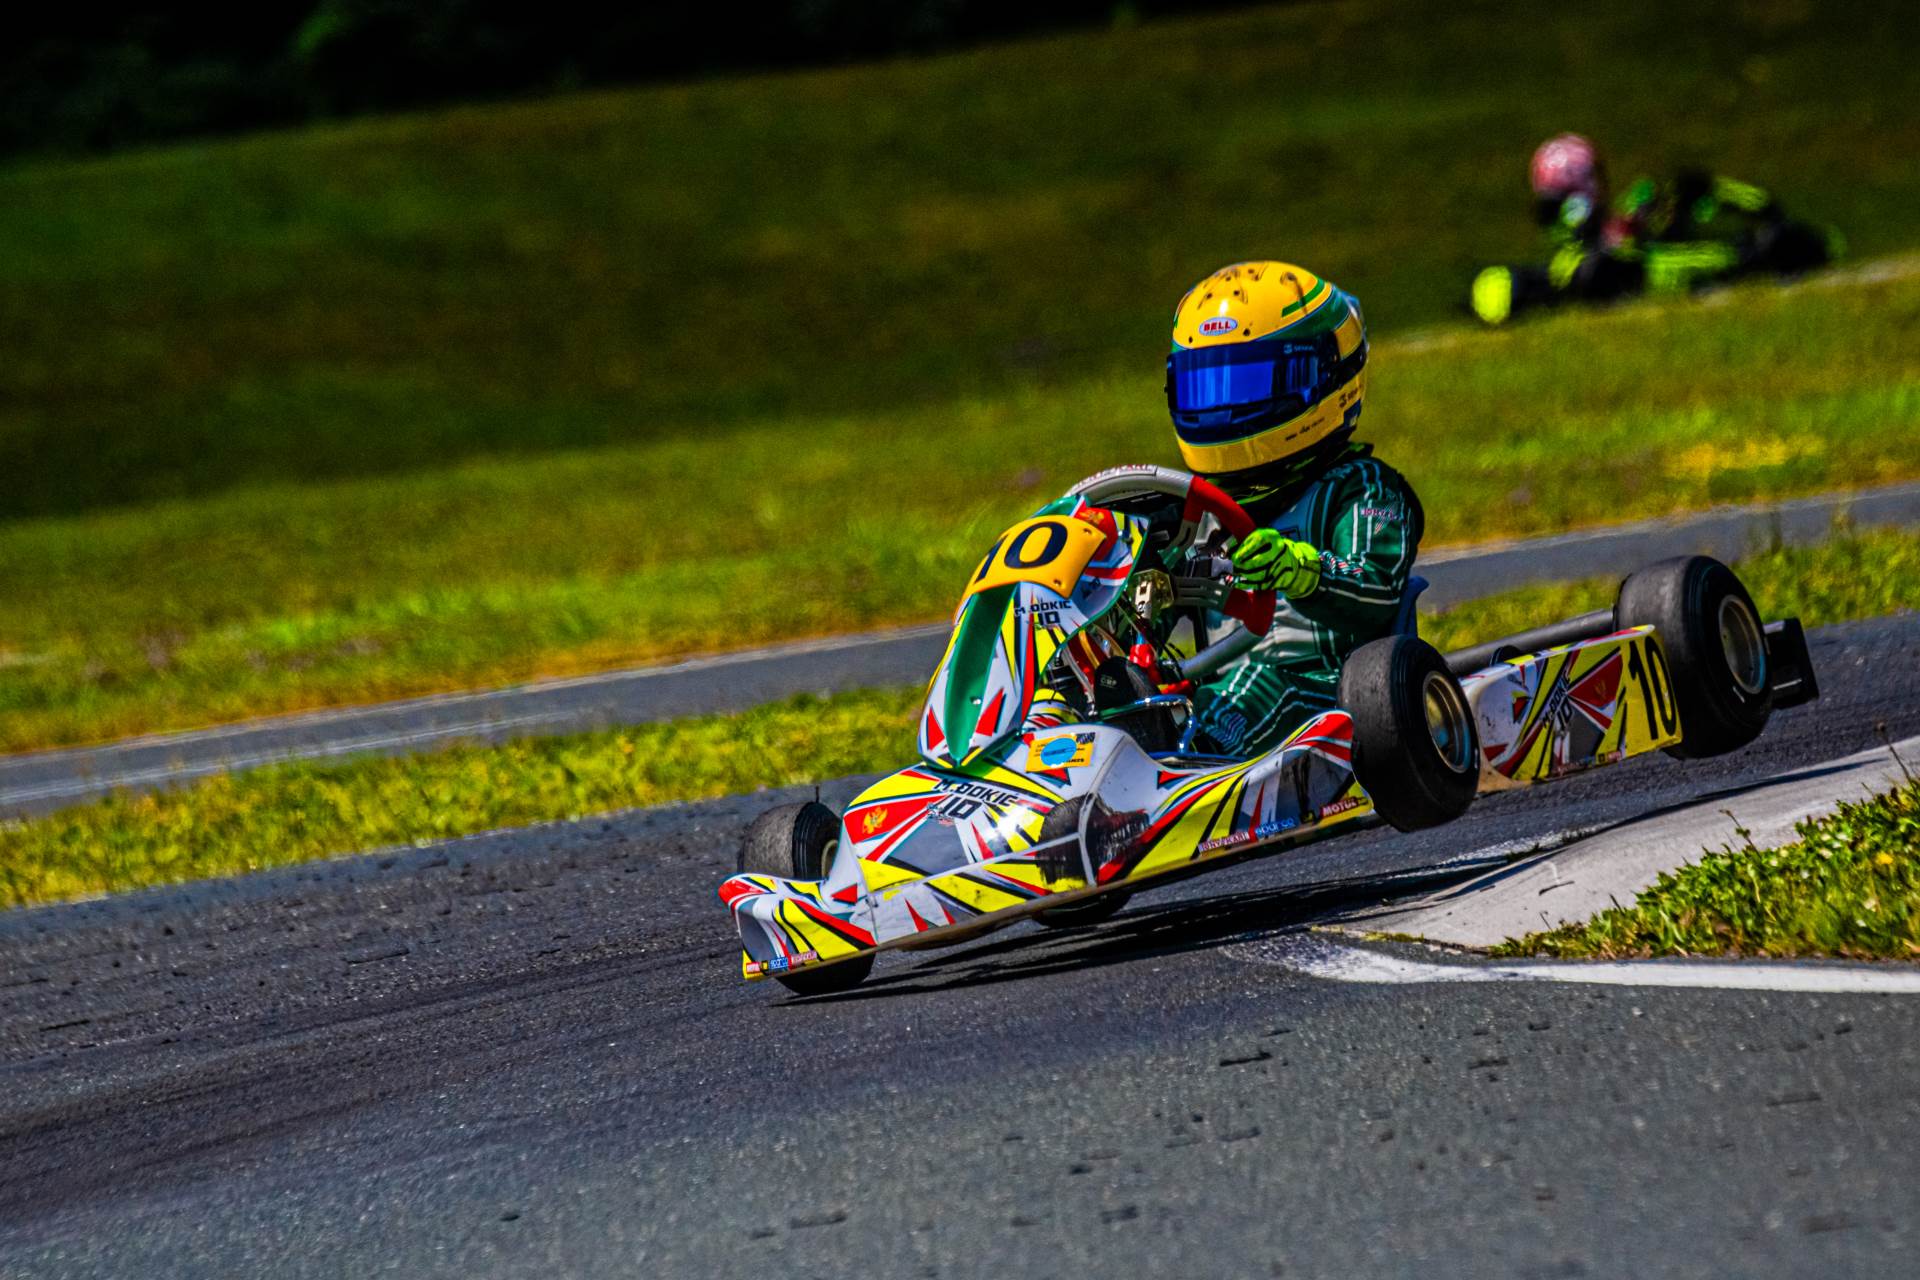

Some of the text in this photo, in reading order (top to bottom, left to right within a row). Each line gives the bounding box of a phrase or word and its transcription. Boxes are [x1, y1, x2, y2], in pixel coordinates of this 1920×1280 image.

[1203, 320, 1232, 332] BELL
[974, 521, 1069, 584] 10
[1629, 635, 1677, 740] 10
[941, 796, 983, 820] 10
[1322, 797, 1358, 817] MOTUL
